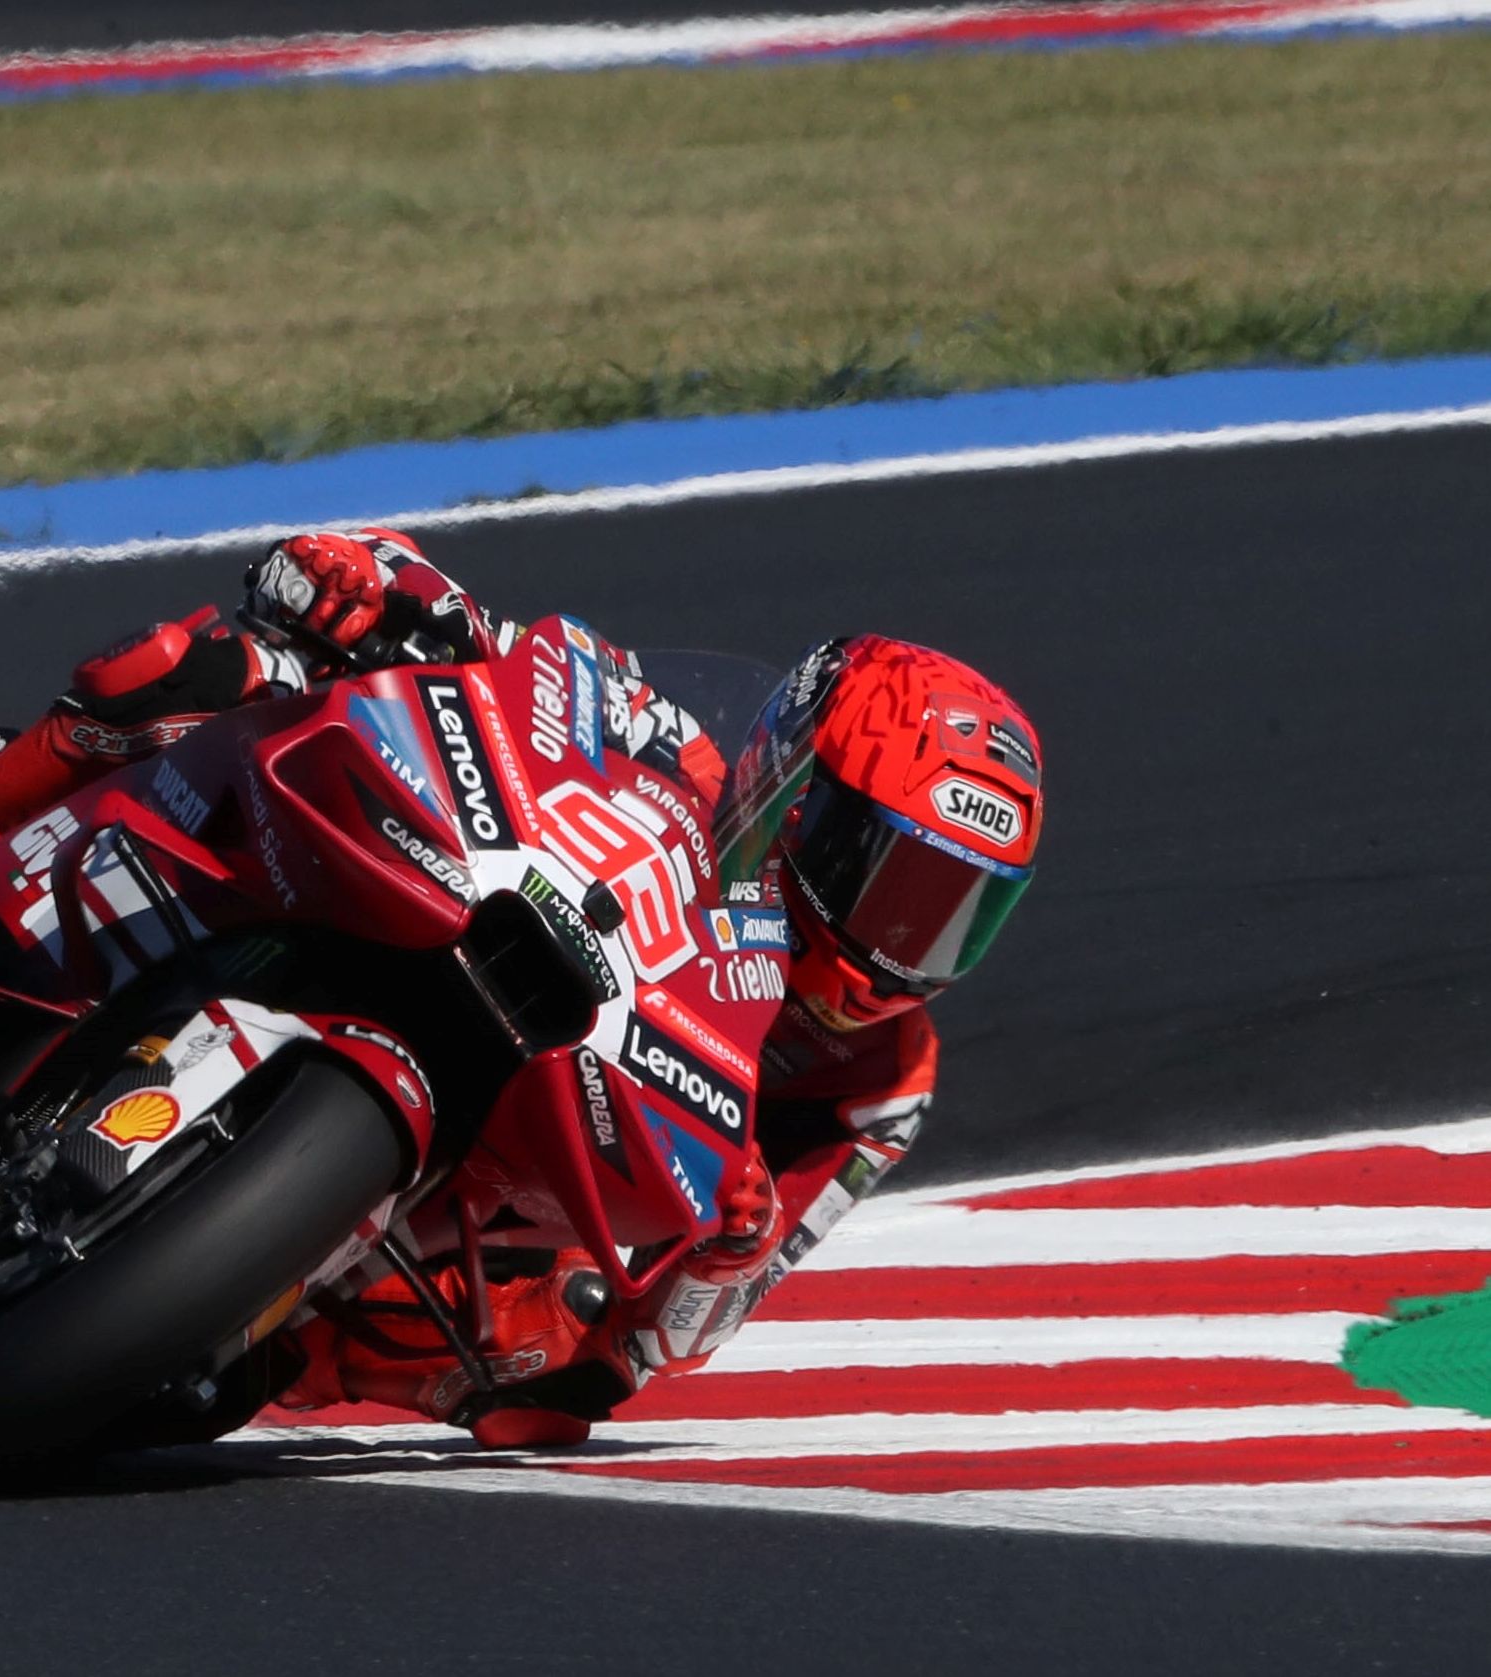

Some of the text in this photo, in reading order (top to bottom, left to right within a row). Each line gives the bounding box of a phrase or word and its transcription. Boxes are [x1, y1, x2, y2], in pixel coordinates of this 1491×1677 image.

[531, 655, 569, 762] riello
[152, 758, 212, 836] DUCATI
[379, 740, 426, 796] TIM
[427, 684, 500, 842] Lenovo
[487, 709, 540, 834] FRECCIAROSSA
[947, 787, 1014, 838] SHOEI
[259, 827, 297, 911] Sport
[380, 816, 476, 903] CARRERA
[728, 881, 761, 902] WRS
[742, 914, 787, 945] ADVANCE
[628, 1024, 742, 1130] Lenovo
[668, 1006, 753, 1079] FRECCIAROSSA
[578, 1049, 616, 1147] CARRERA
[671, 1156, 703, 1218] TIM
[669, 1287, 707, 1332] Unipol
